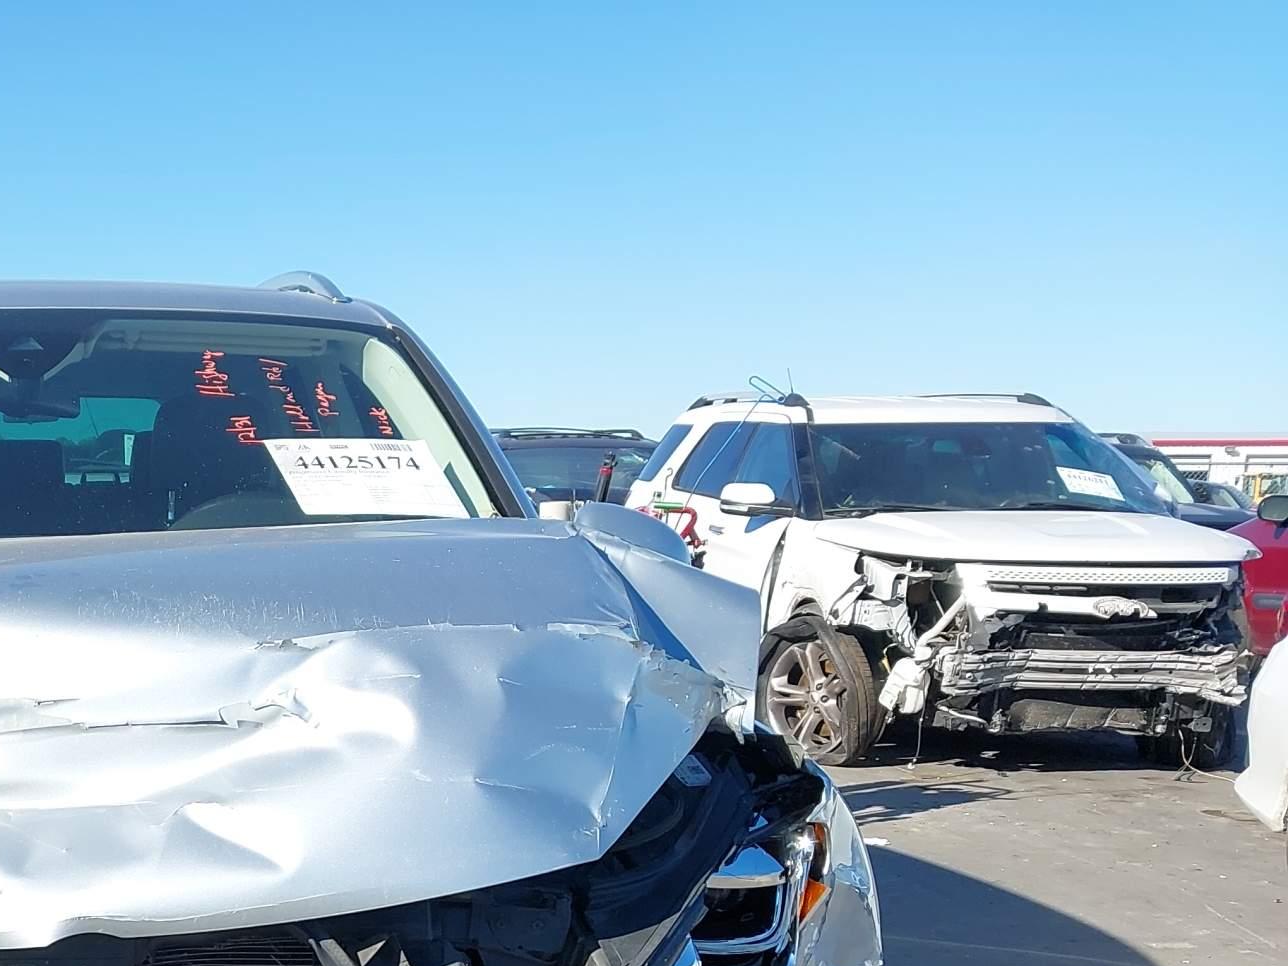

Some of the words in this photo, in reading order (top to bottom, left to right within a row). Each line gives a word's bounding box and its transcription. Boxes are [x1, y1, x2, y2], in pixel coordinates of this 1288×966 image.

[225, 415, 264, 443] 12/31
[369, 407, 393, 435] Nick
[294, 455, 421, 471] 44125174
